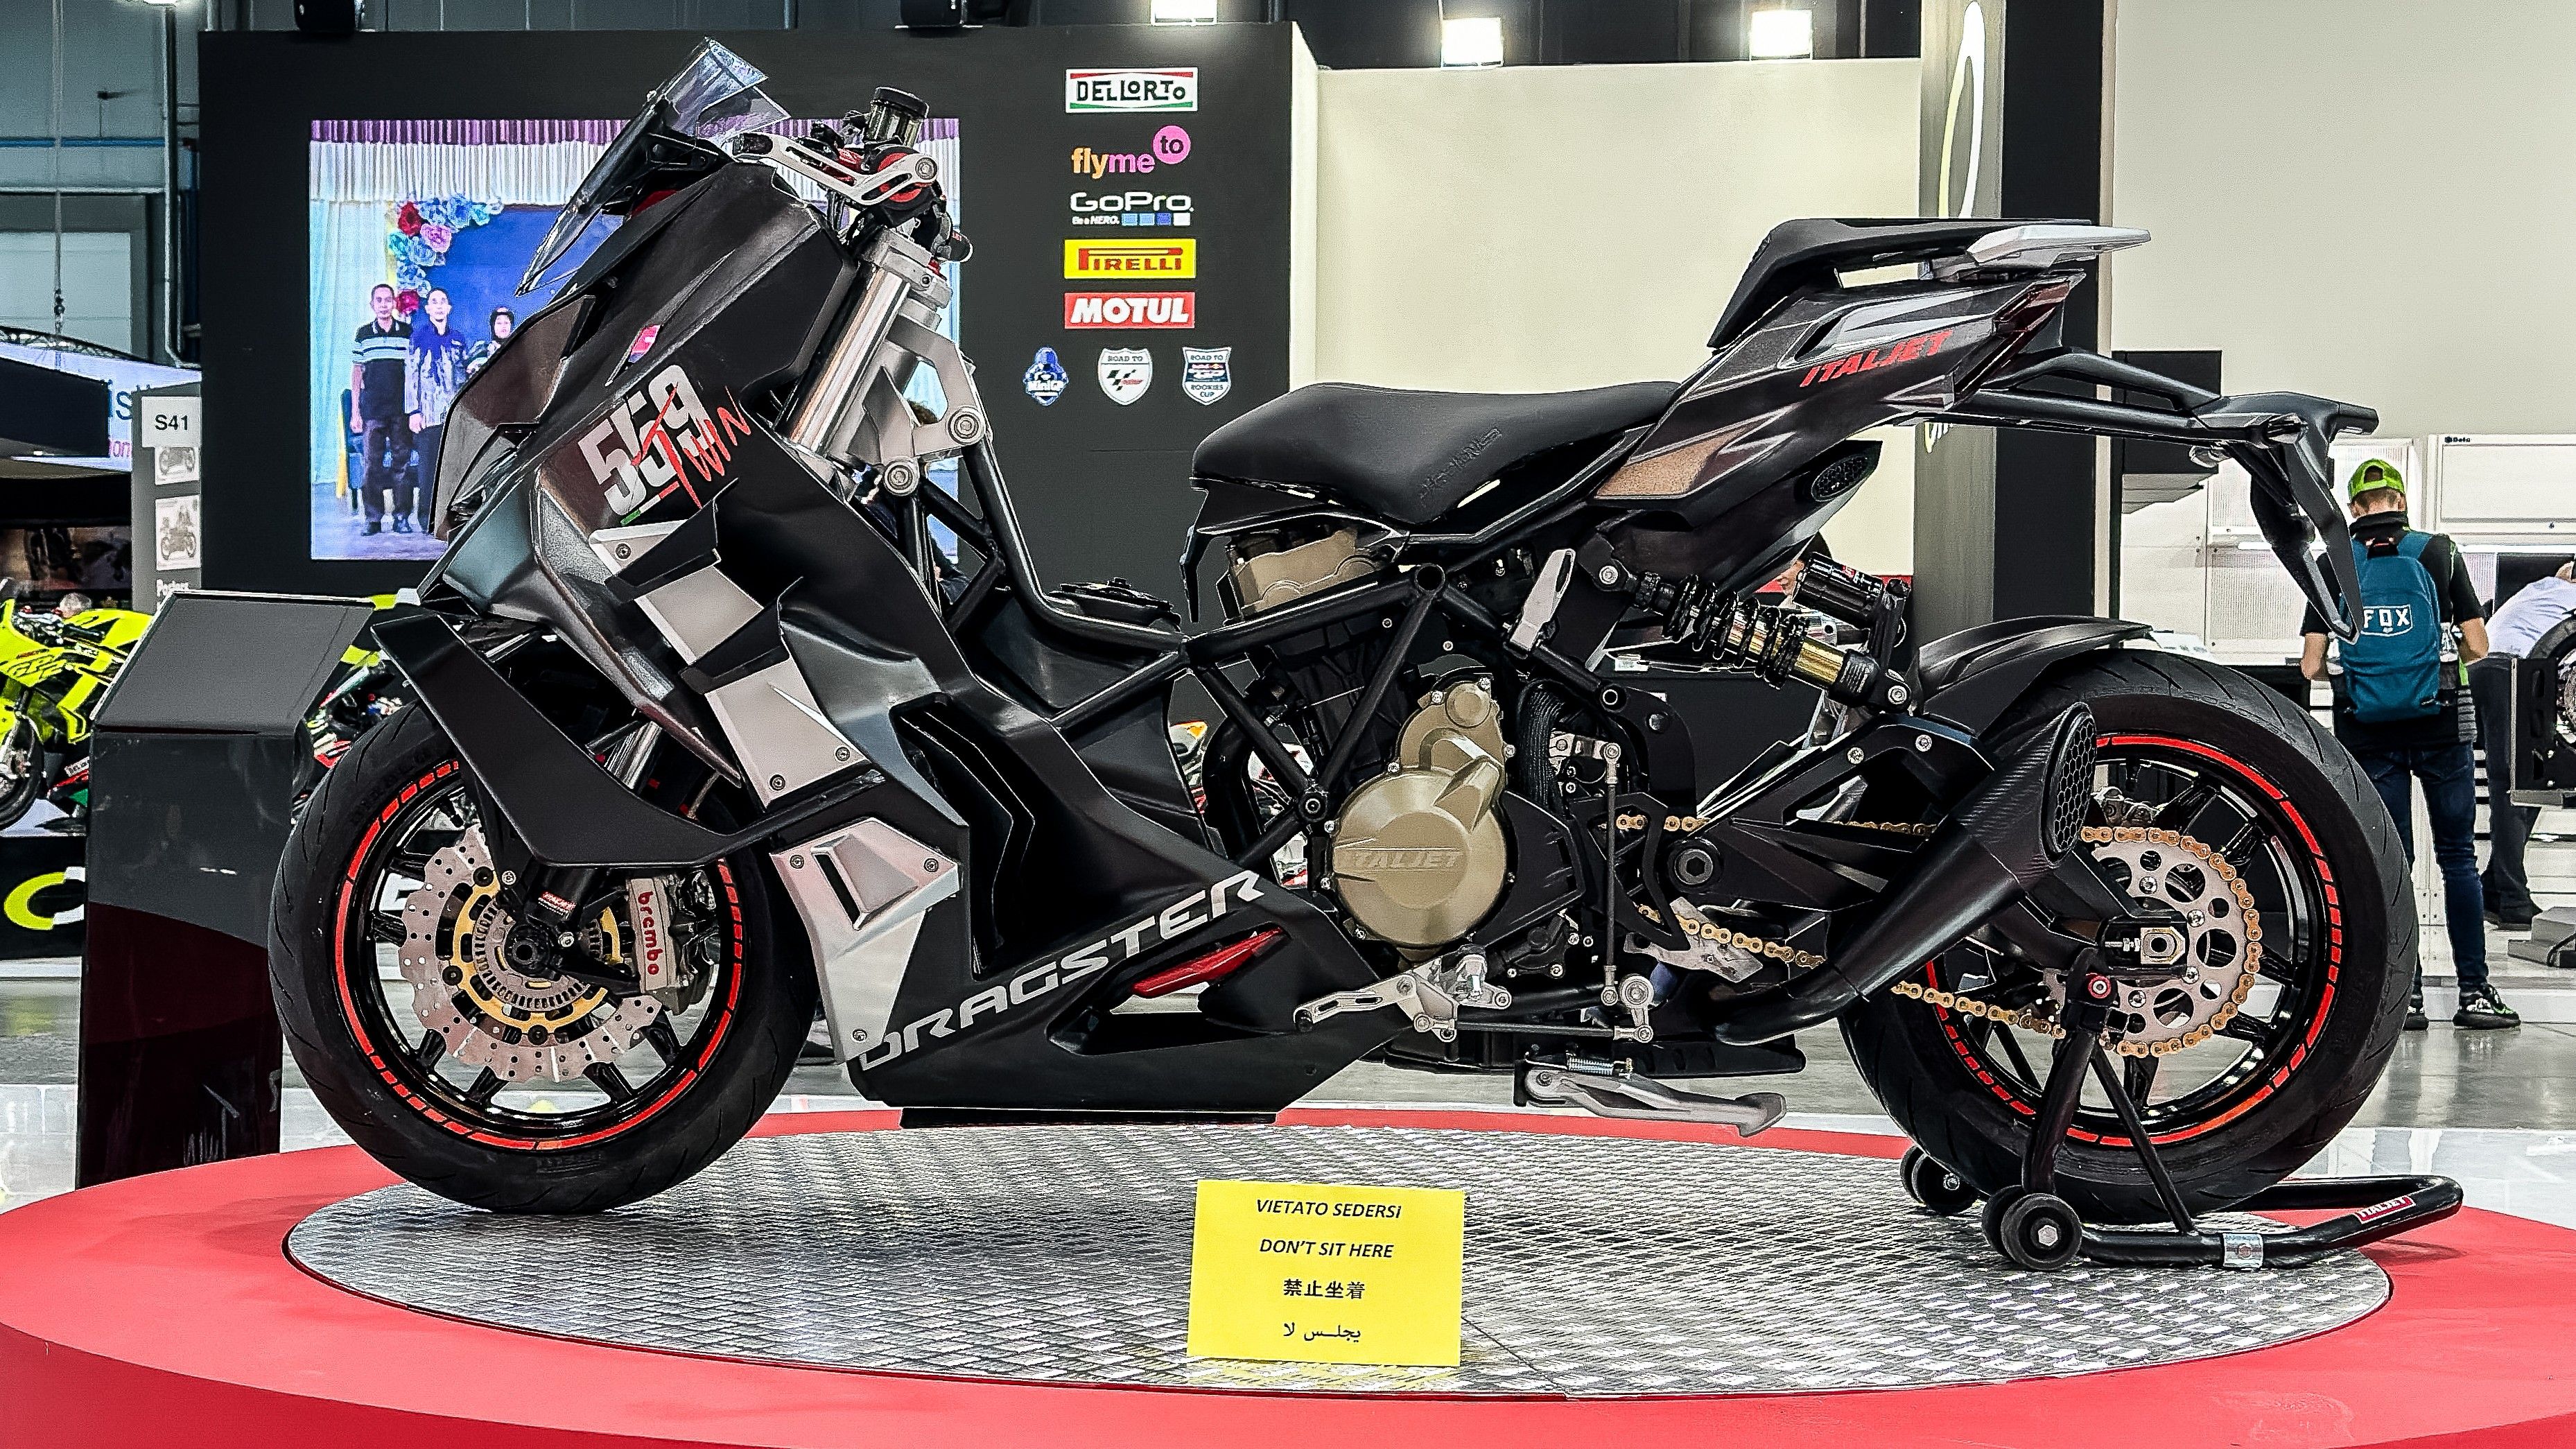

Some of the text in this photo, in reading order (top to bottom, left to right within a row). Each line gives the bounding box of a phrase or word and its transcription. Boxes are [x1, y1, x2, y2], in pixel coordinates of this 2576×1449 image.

[1160, 135, 1185, 155] to
[1078, 247, 1184, 270] PIRELLI
[1070, 297, 1190, 324] MOTUL
[1799, 329, 1953, 388] ITALJET
[155, 414, 189, 431] S41
[578, 364, 717, 517] 559
[2362, 607, 2411, 630] FOX
[637, 890, 663, 975] brembo
[857, 869, 1265, 1071] DRAGSTER
[1256, 1199, 1402, 1219] VIETATO SEDERSI
[1319, 1242, 1346, 1256] SIT
[1349, 1243, 1395, 1258] HERE
[1283, 1278, 1366, 1300] 禁止坐着
[1283, 1321, 1296, 1337] لا
